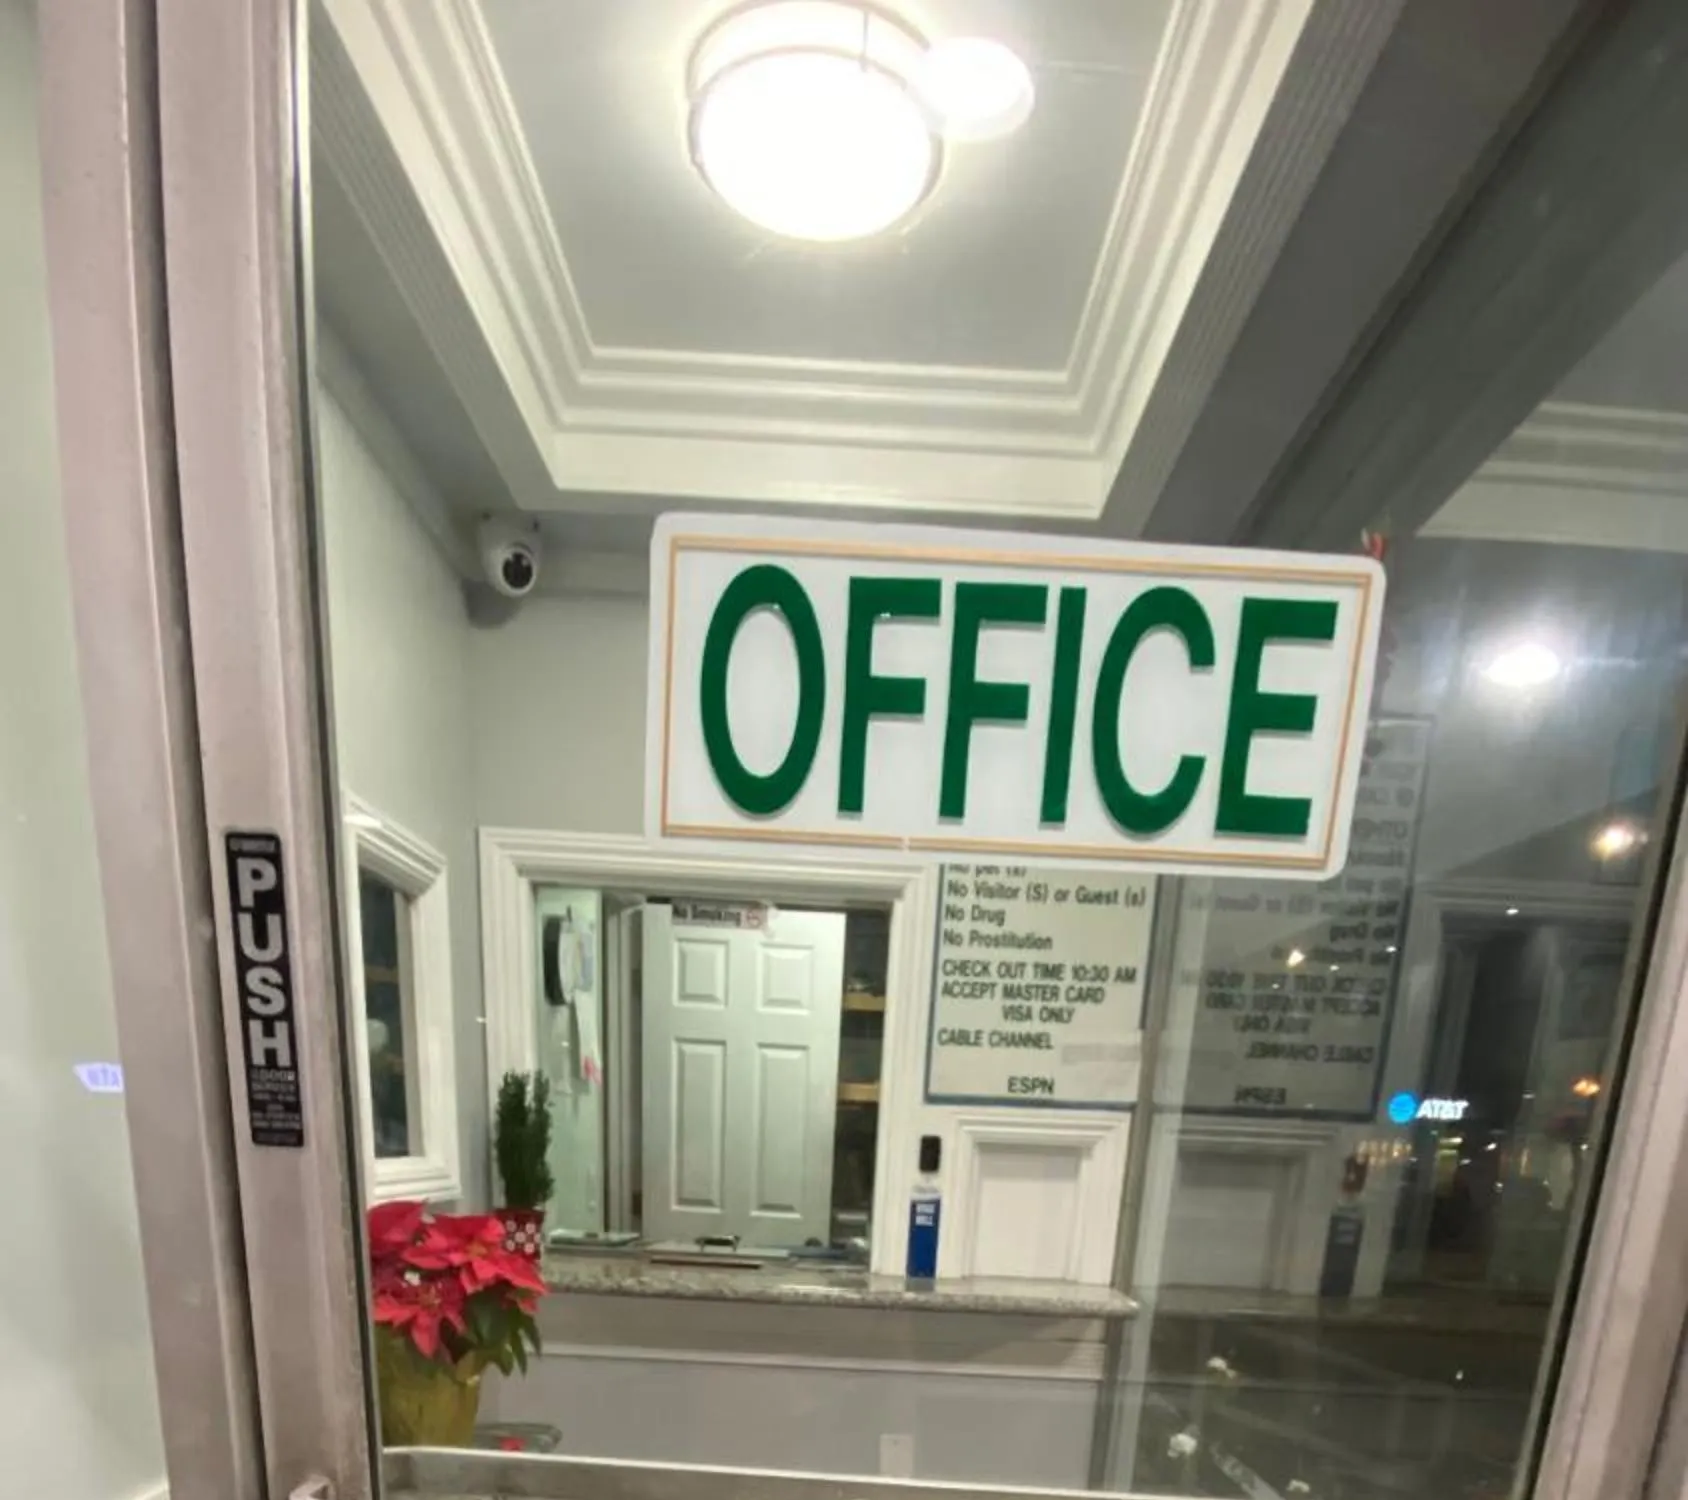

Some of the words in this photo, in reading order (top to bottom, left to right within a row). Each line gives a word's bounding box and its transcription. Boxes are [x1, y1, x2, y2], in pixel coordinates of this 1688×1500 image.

[700, 563, 1339, 836] OFFICE
[947, 880, 968, 897] No
[974, 881, 1021, 900] Visitor
[1054, 889, 1070, 902] or
[1075, 884, 1118, 905] Guest
[945, 904, 965, 921] No
[971, 904, 1006, 927] Drug
[943, 928, 964, 947] No
[969, 930, 1053, 950] Prostitution
[236, 857, 291, 1068] PUSH
[941, 959, 991, 977] CHECK
[997, 962, 1026, 979] OUT
[1032, 963, 1066, 981] TIME
[1071, 965, 1109, 982] 10:30
[1114, 967, 1137, 983] AM
[941, 981, 997, 999] ACCEPT
[1002, 984, 1060, 1001] MASTER
[1065, 986, 1105, 1004] CARD
[1002, 1005, 1032, 1021] VISA
[1039, 1006, 1075, 1023] ONLY
[937, 1029, 983, 1046] CABLE
[988, 1030, 1054, 1049] CHANNEL
[1007, 1076, 1055, 1095] ESPN
[1416, 1098, 1469, 1120] AT&T
